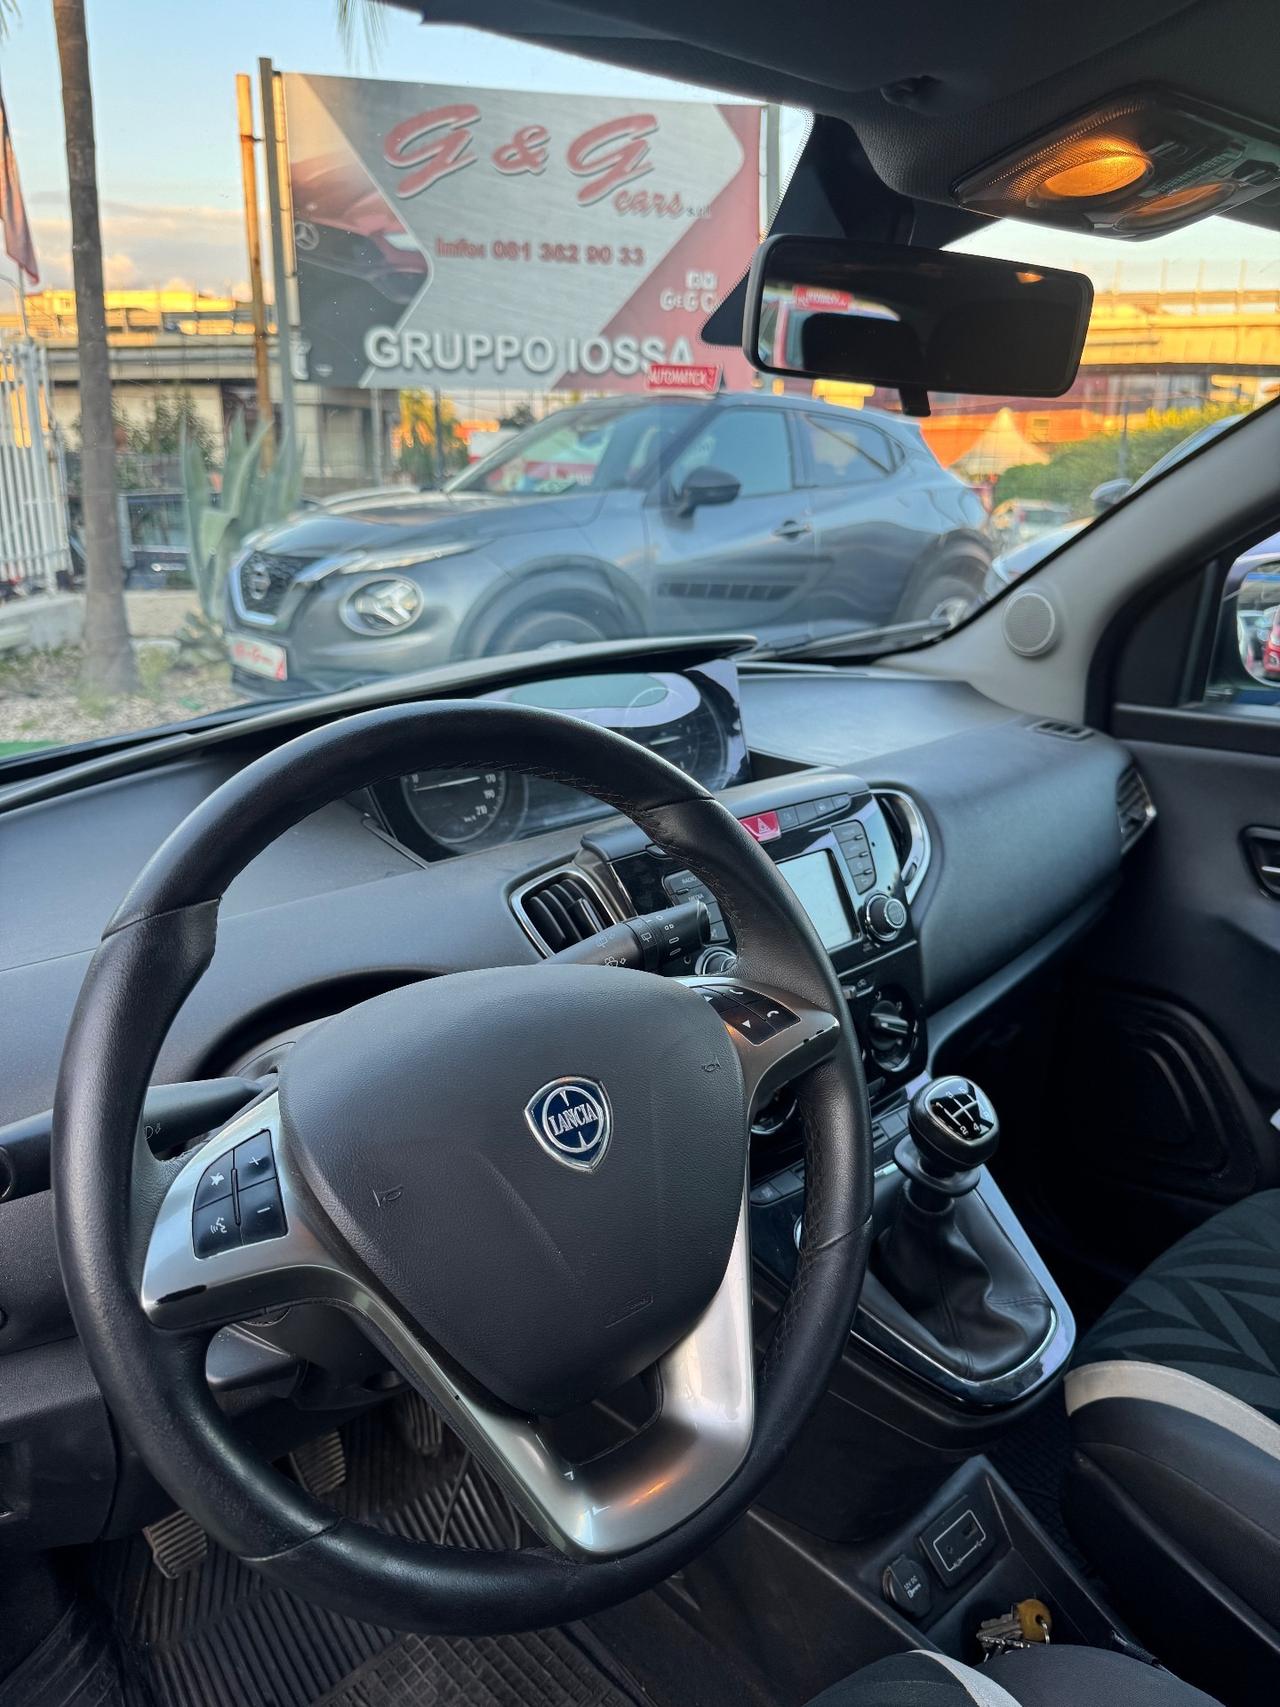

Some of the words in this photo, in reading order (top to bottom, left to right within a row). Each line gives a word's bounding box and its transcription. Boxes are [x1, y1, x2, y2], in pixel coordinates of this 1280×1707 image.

[383, 103, 482, 199] G
[491, 124, 551, 176] &
[566, 113, 660, 208] G
[365, 327, 554, 372] GRUPPO
[568, 336, 694, 374] IOSSA
[548, 1102, 598, 1136] LANCIA
[960, 1125, 969, 1136] 2
